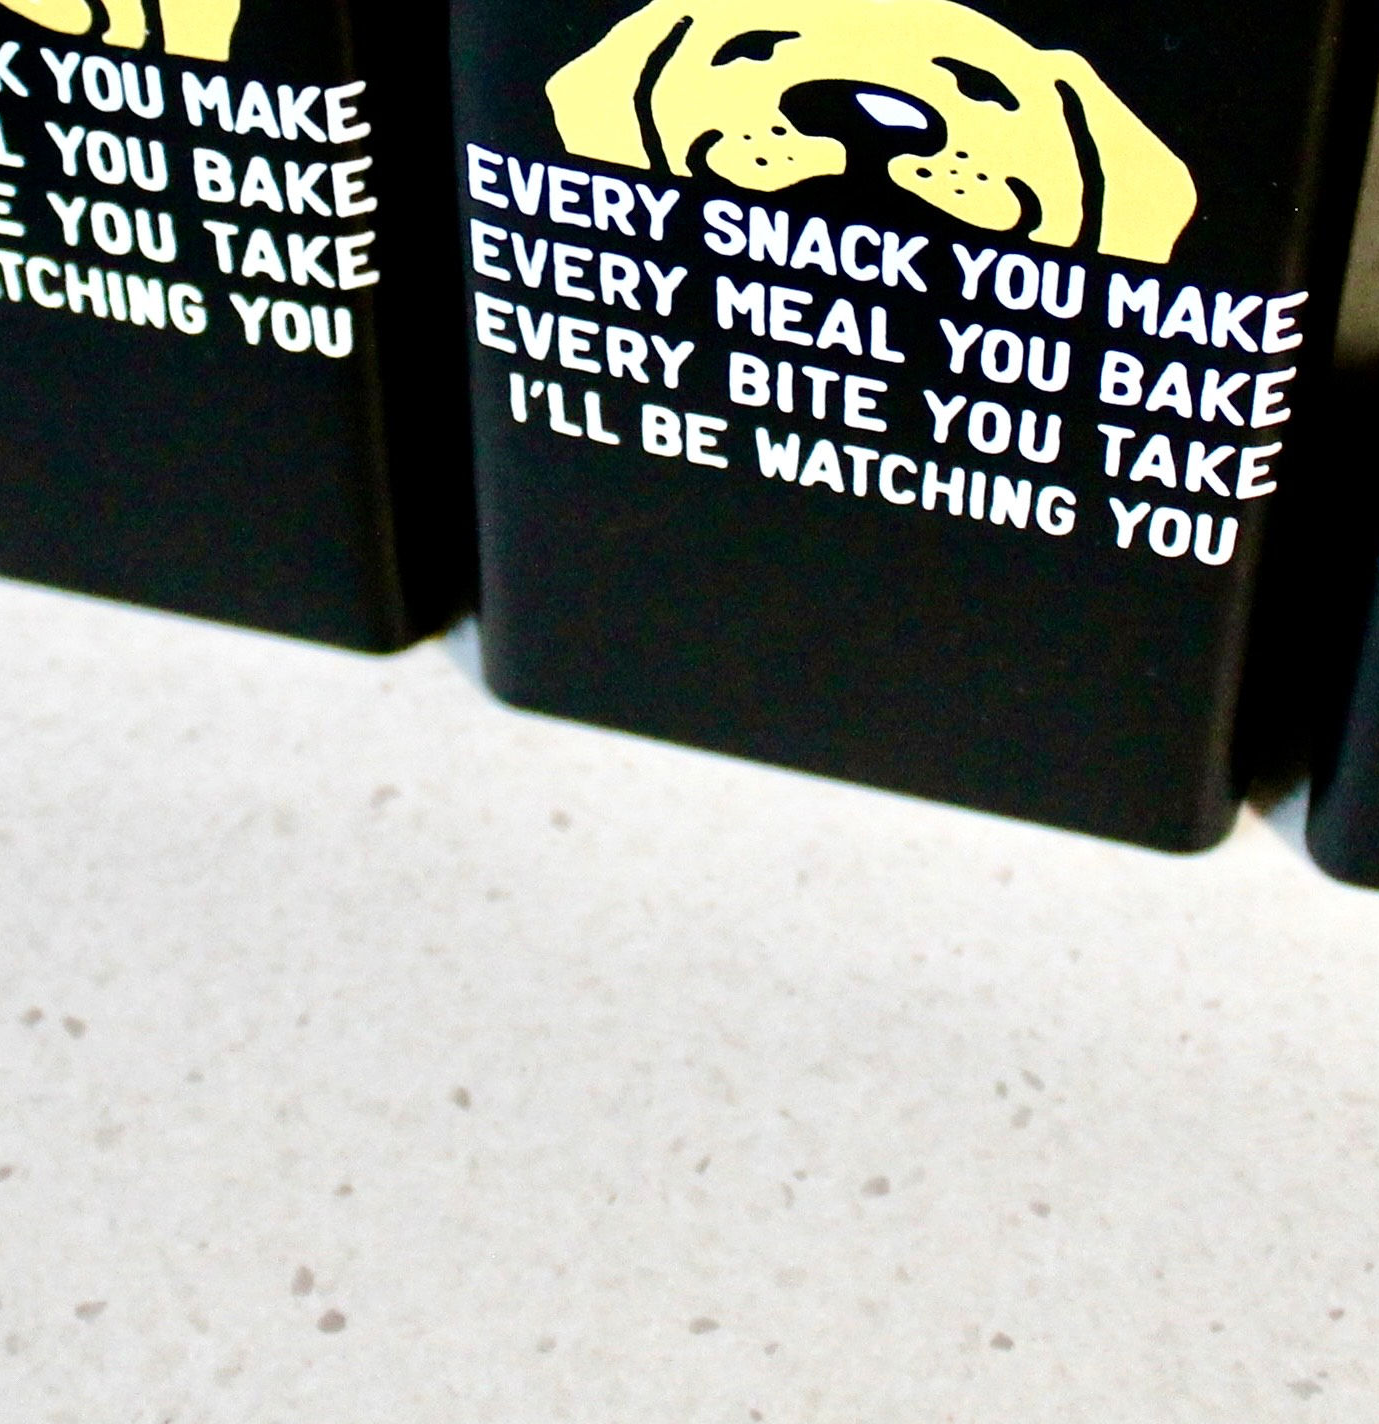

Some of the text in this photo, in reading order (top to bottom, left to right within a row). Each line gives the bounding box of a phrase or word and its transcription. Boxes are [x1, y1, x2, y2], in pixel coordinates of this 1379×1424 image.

[40, 48, 164, 120] YOU
[181, 71, 372, 145] MAKE
[45, 122, 168, 192] YOU
[193, 147, 378, 218] BAKE
[47, 193, 177, 263] YOU
[202, 220, 380, 291] TAKE
[466, 143, 1309, 354] EVERY SNACK YOU MAKE
[229, 292, 353, 359] YOU
[470, 218, 1297, 429] EVERY MEAL YOU BAKE
[474, 291, 1283, 500] EVERY BITE YOU TAKE
[509, 372, 1239, 566] I'LL BE WATCHING YOU
